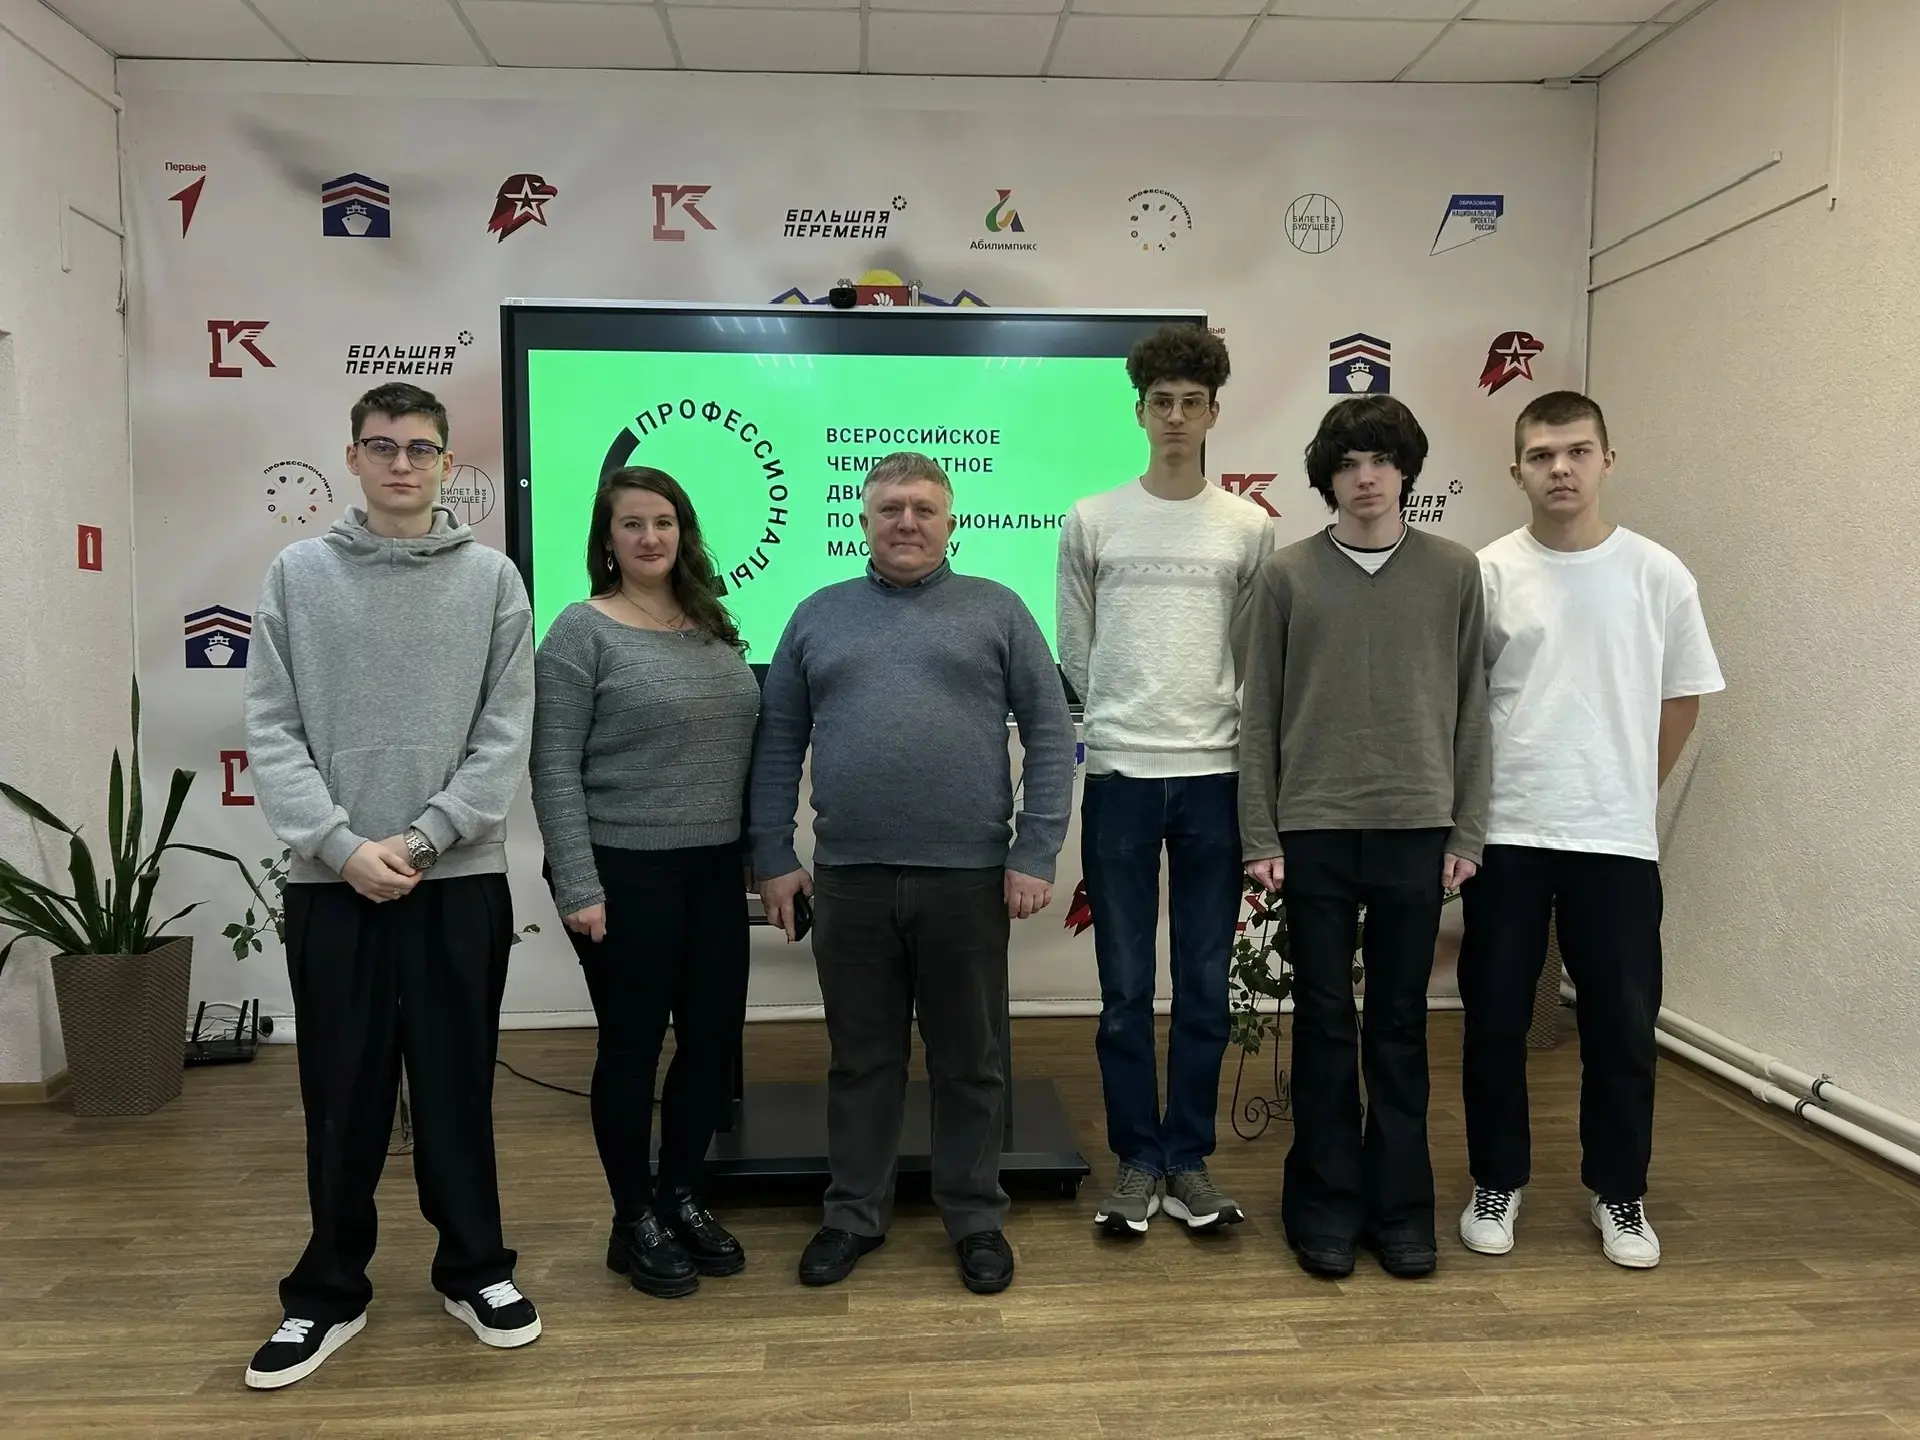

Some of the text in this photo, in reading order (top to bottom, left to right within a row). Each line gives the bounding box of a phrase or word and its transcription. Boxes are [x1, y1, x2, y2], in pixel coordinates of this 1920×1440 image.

[165, 161, 206, 173] Первые
[786, 209, 890, 223] БОЛЬШАЯ
[1293, 215, 1320, 223] БИЛЕТ
[783, 224, 887, 239] ПЕРЕМЕНА
[1293, 223, 1330, 231] БУДУЩЕЕ
[969, 239, 1038, 250] Абилимпикс
[348, 344, 457, 359] БОЛЬШАЯ
[345, 360, 453, 375] ПЕРЕМЕНА
[826, 425, 1001, 445] ВСЕРОССИЙСКОЕ
[440, 488, 471, 496] БИЛЕТ
[635, 398, 789, 589] ПРОФЕССИОНАЛЫ
[440, 496, 481, 504] БУДУЩЕЕ
[827, 512, 854, 528] ПО
